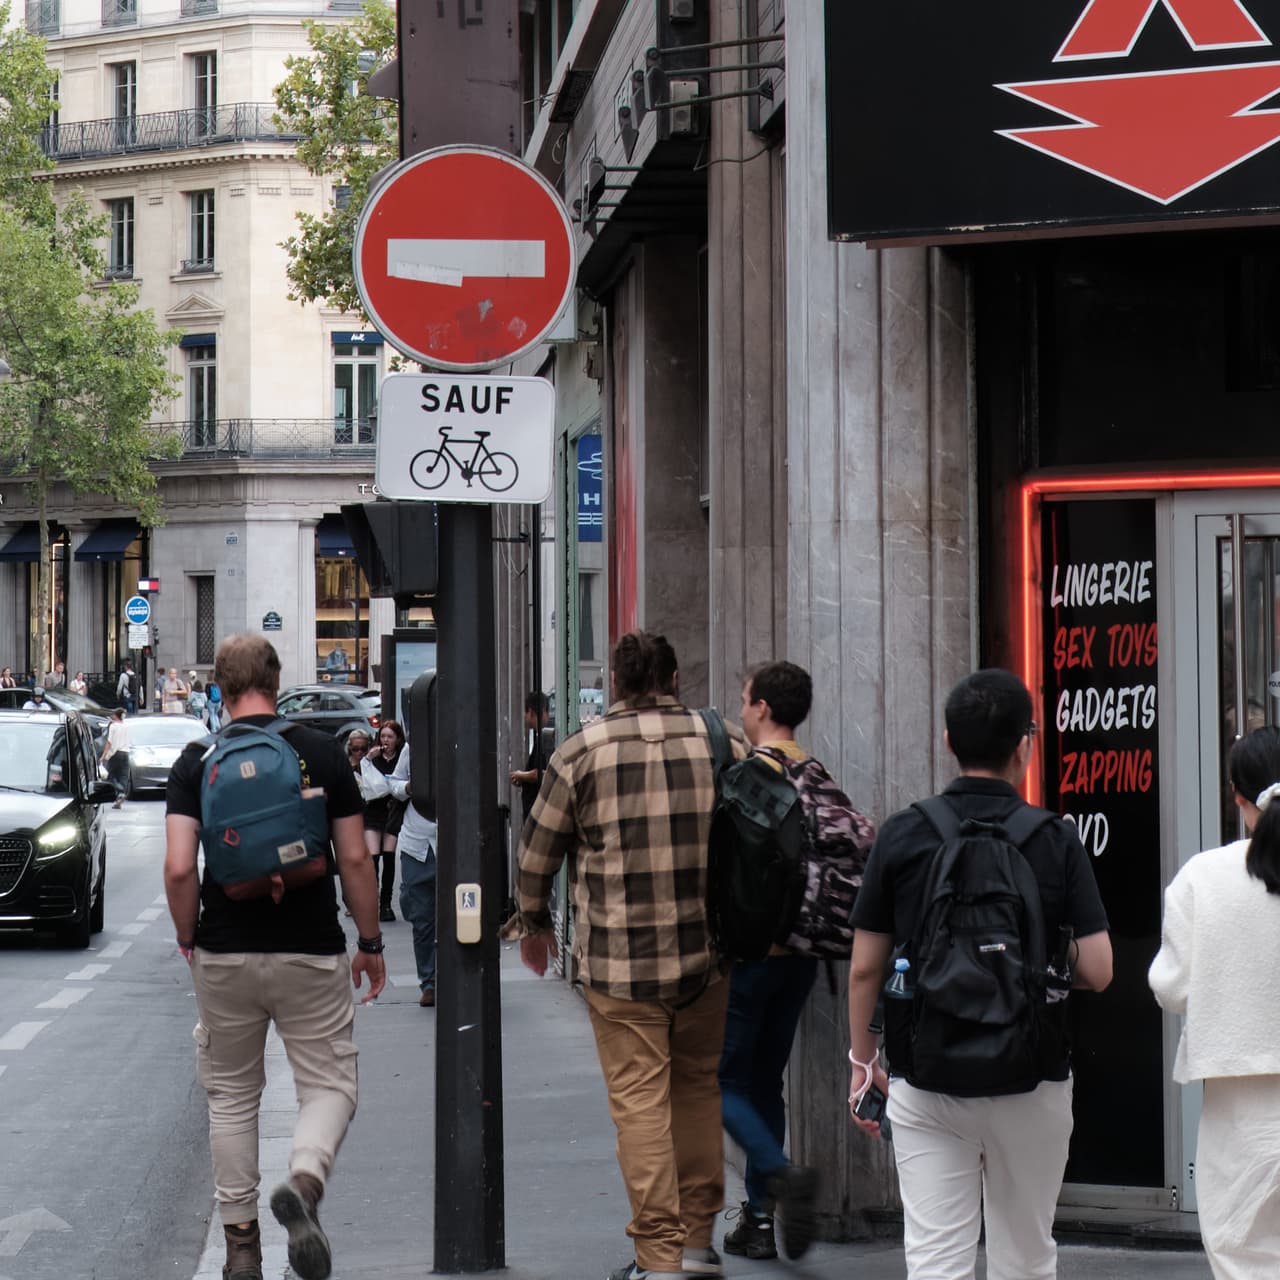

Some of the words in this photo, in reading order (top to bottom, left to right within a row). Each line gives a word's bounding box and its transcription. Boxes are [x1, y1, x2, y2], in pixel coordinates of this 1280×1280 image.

[421, 383, 514, 414] SAUF
[1050, 560, 1153, 608] LINGERIE
[1053, 625, 1097, 670] SEX
[1107, 622, 1158, 669] TOYS
[1056, 684, 1156, 733] GADGETS
[1059, 749, 1153, 795] ZAPPING
